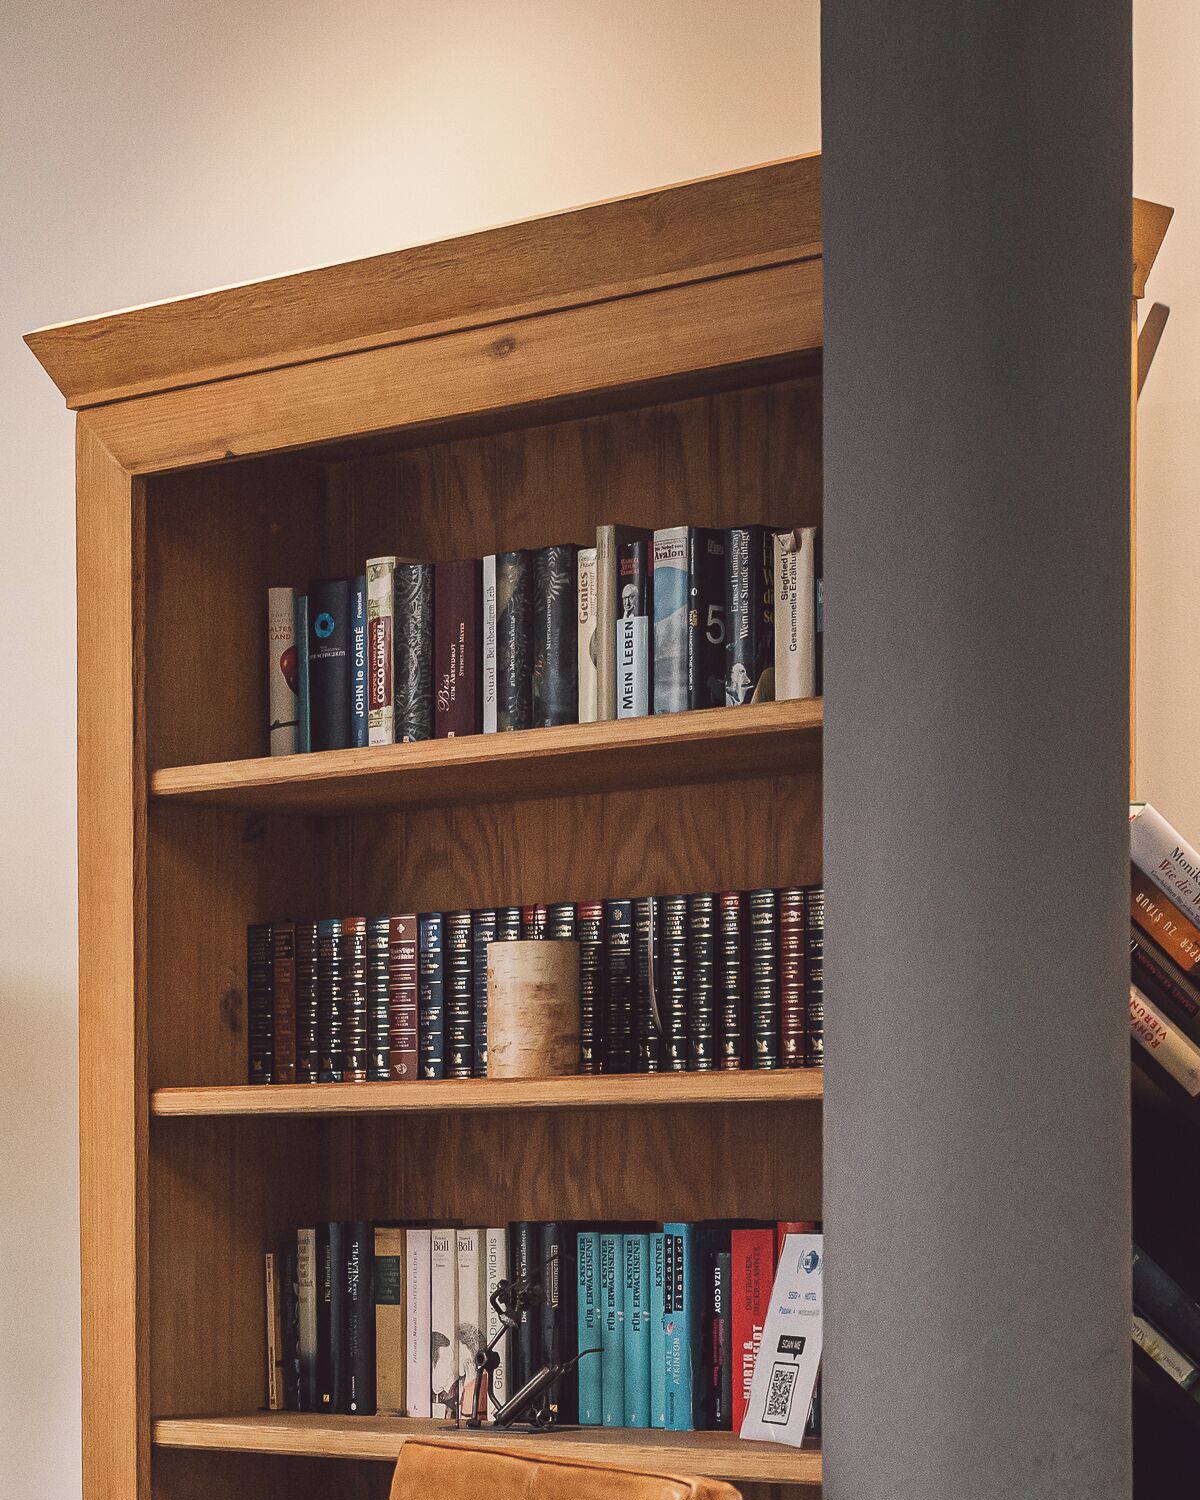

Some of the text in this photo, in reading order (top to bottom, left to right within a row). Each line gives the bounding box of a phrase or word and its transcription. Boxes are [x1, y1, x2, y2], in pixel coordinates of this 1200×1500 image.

[655, 548, 684, 560] Avalon
[731, 531, 741, 612] Ernest Hemingway
[579, 571, 589, 624] Genies
[740, 531, 750, 640] Wem die Stunde schlägt
[781, 557, 789, 601] Siegfried
[789, 551, 798, 652] Gesammelte Erzählun
[486, 586, 495, 703] Souad Bei lebendigem Leib
[706, 604, 725, 644] 5
[355, 626, 364, 667] CARRÉ
[377, 620, 385, 703] COCO CHANEL
[623, 621, 634, 709] MEIN LEBEN
[356, 671, 364, 682] le
[438, 674, 450, 711] Biss
[355, 684, 364, 718] JOHN
[1157, 858, 1195, 897] Wie die
[1134, 892, 1164, 922] STAUB
[1163, 921, 1177, 935] ZU
[1131, 1000, 1169, 1040] VIERUN
[433, 1240, 449, 1251] Böll
[458, 1239, 473, 1251] Böll
[489, 1238, 497, 1336] Die Wildnis
[585, 1237, 593, 1329] FÜR ERWACHSENE
[607, 1239, 615, 1331] FÜR ERWACHSENE
[632, 1310, 640, 1332] FÜR
[672, 1337, 680, 1385] ATKINSON
[781, 1339, 802, 1350] SCAN ME
[743, 1340, 753, 1400] HJORTH &
